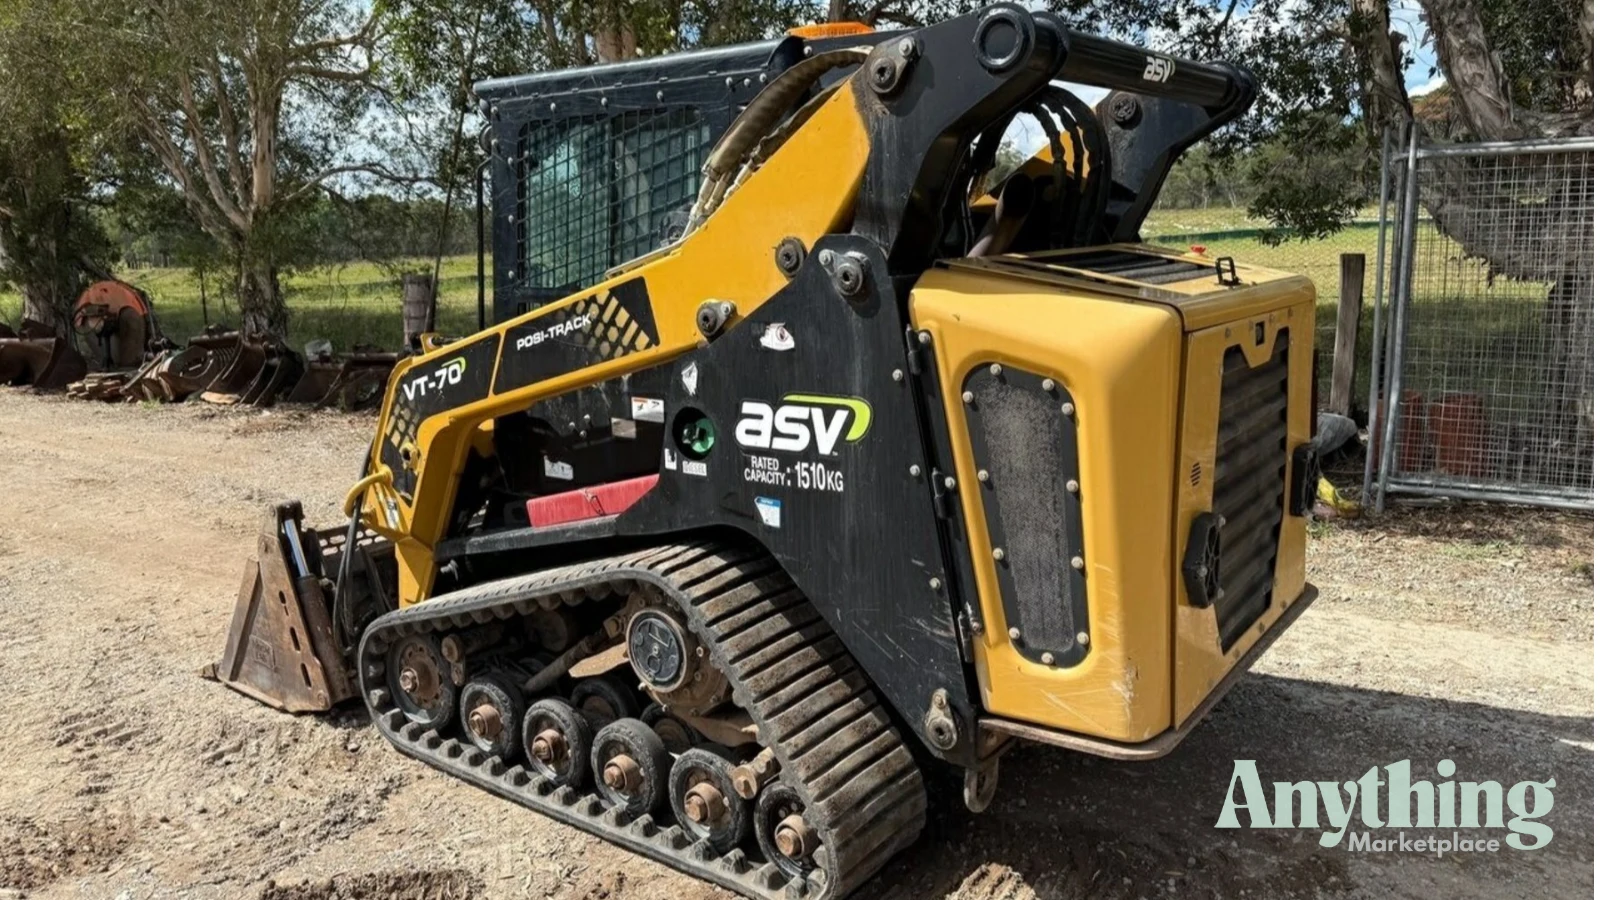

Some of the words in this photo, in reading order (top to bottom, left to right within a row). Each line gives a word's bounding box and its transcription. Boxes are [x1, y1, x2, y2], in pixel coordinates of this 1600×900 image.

[516, 313, 592, 351] POSI-TRACK
[403, 363, 462, 401] VT-70
[751, 456, 779, 471] RATED
